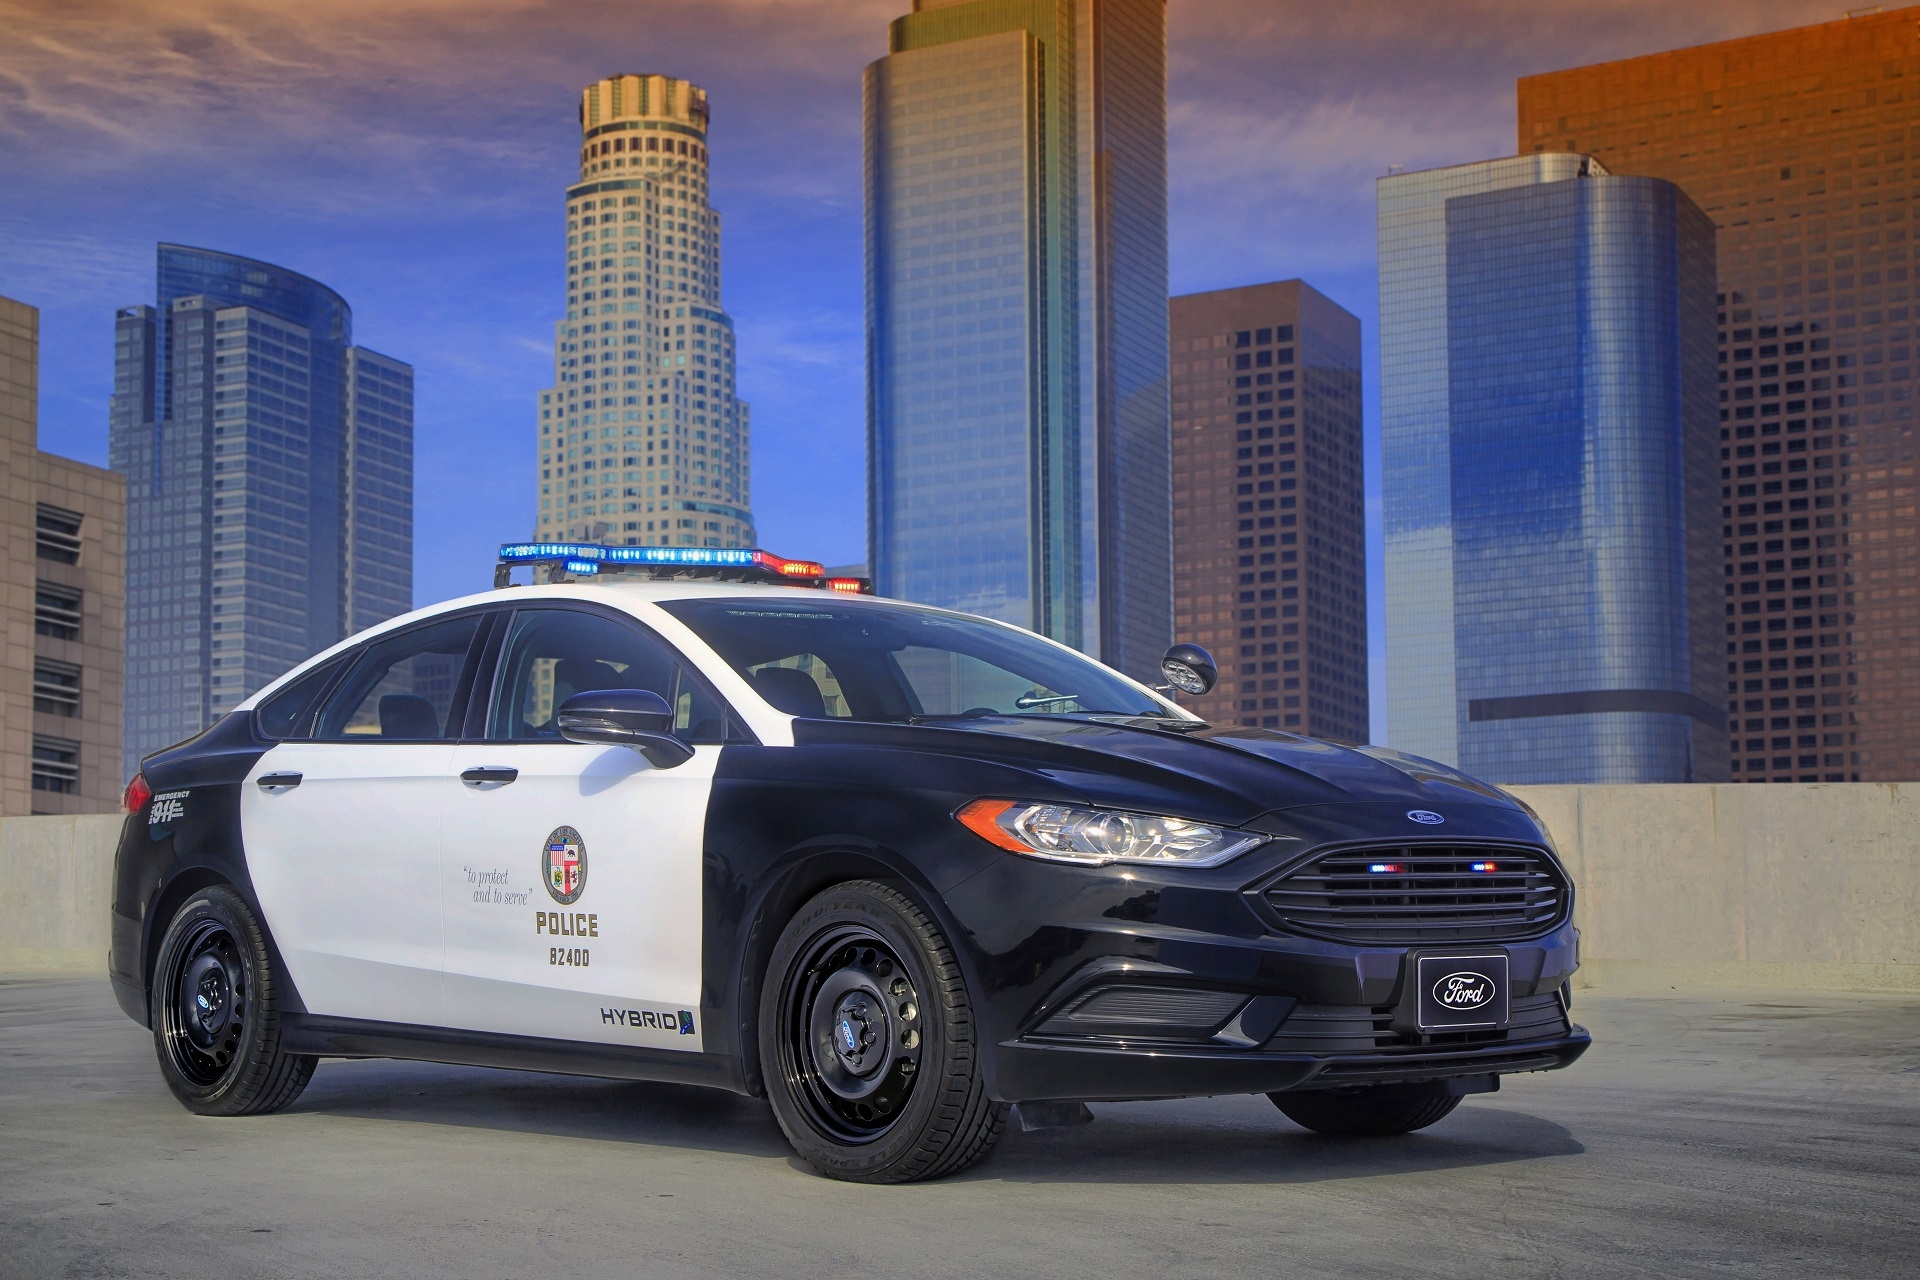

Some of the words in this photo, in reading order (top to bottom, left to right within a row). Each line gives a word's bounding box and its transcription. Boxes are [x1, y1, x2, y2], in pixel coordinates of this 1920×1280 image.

[154, 791, 190, 802] EMERGENCY
[478, 868, 509, 888] protect
[473, 885, 491, 904] and
[493, 887, 502, 904] to
[536, 911, 599, 938] POLICE
[549, 947, 590, 967] 82400
[1443, 977, 1485, 1005] Ford
[600, 1007, 678, 1031] HYBRID
